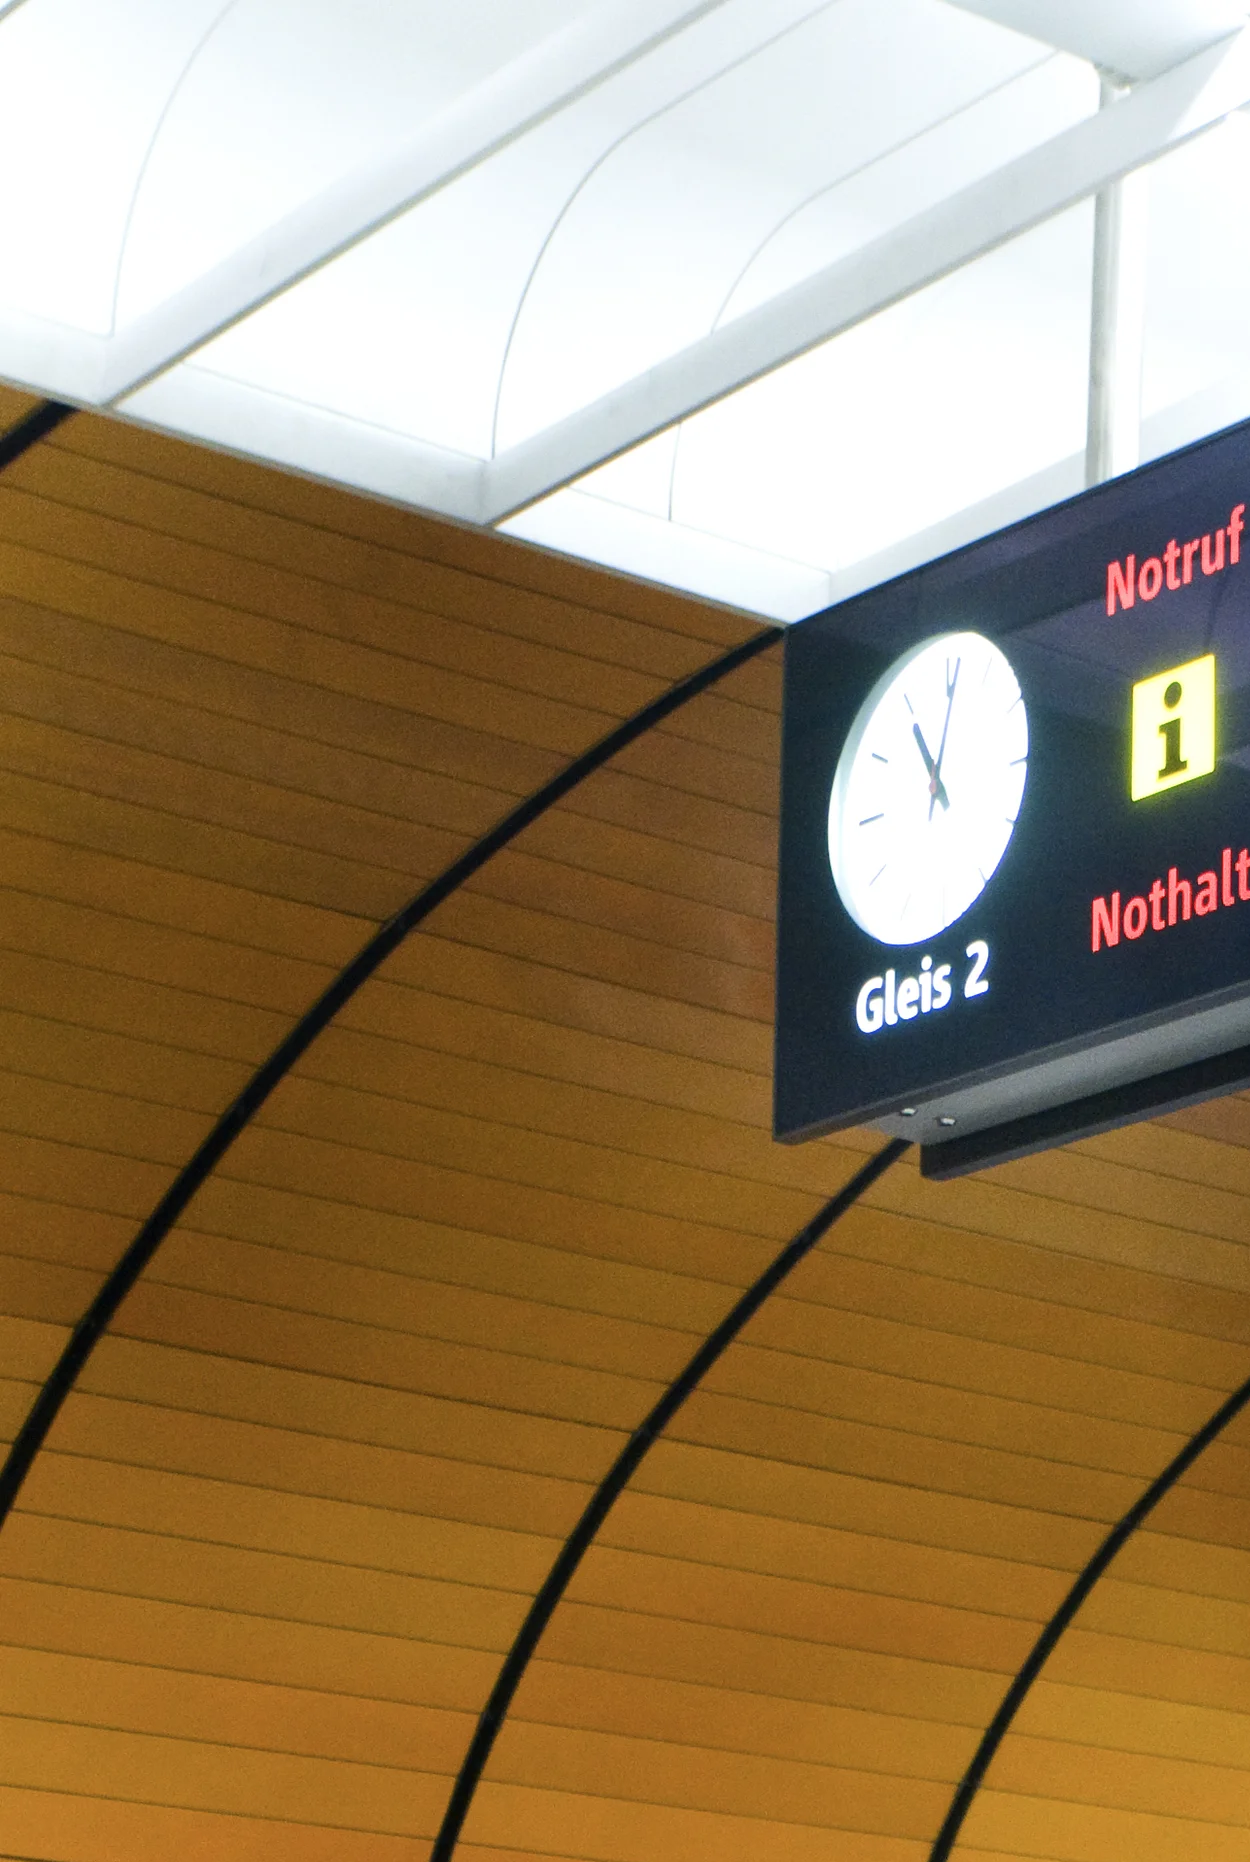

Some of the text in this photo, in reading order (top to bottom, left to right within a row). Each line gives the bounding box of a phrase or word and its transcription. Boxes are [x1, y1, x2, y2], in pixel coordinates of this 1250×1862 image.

[1107, 503, 1246, 617] Notruf
[855, 940, 989, 1035] Gleis 2
